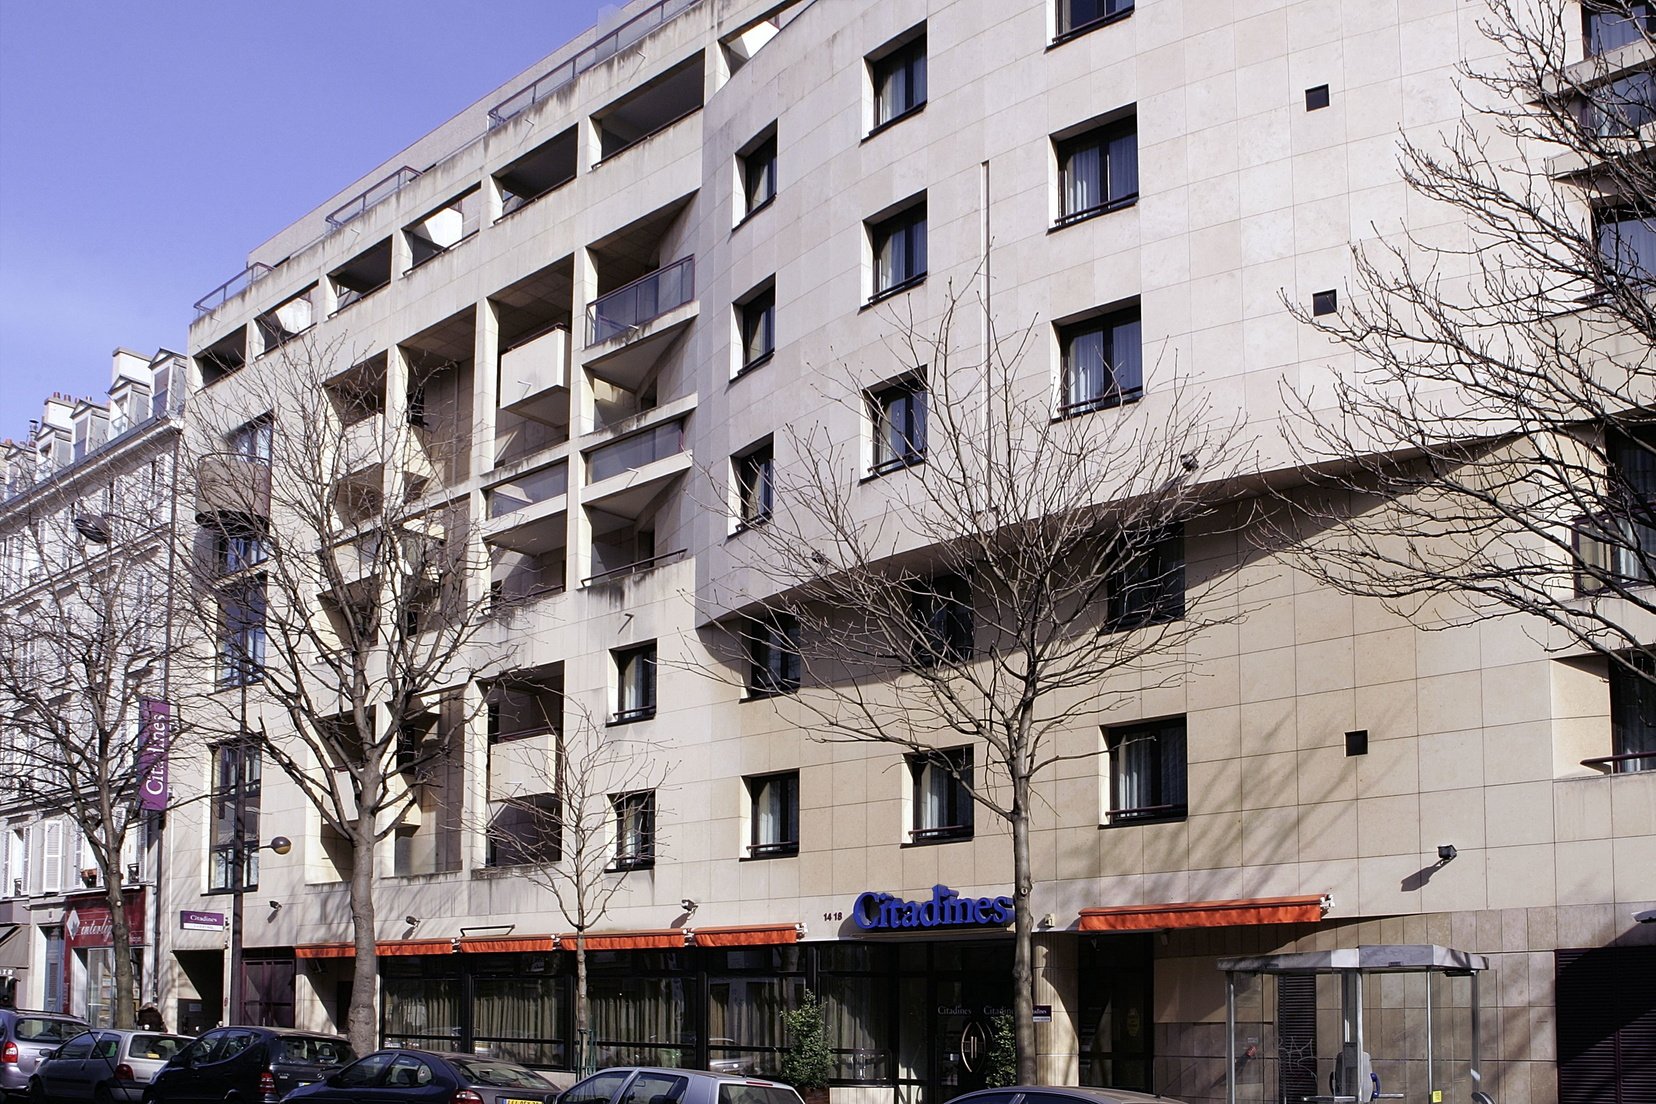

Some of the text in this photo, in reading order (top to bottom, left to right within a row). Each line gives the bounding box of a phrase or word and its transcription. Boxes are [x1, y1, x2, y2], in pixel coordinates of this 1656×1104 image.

[853, 884, 1016, 929] Citadines
[937, 1005, 972, 1015] Citadines
[983, 1005, 1015, 1015] Citadin
